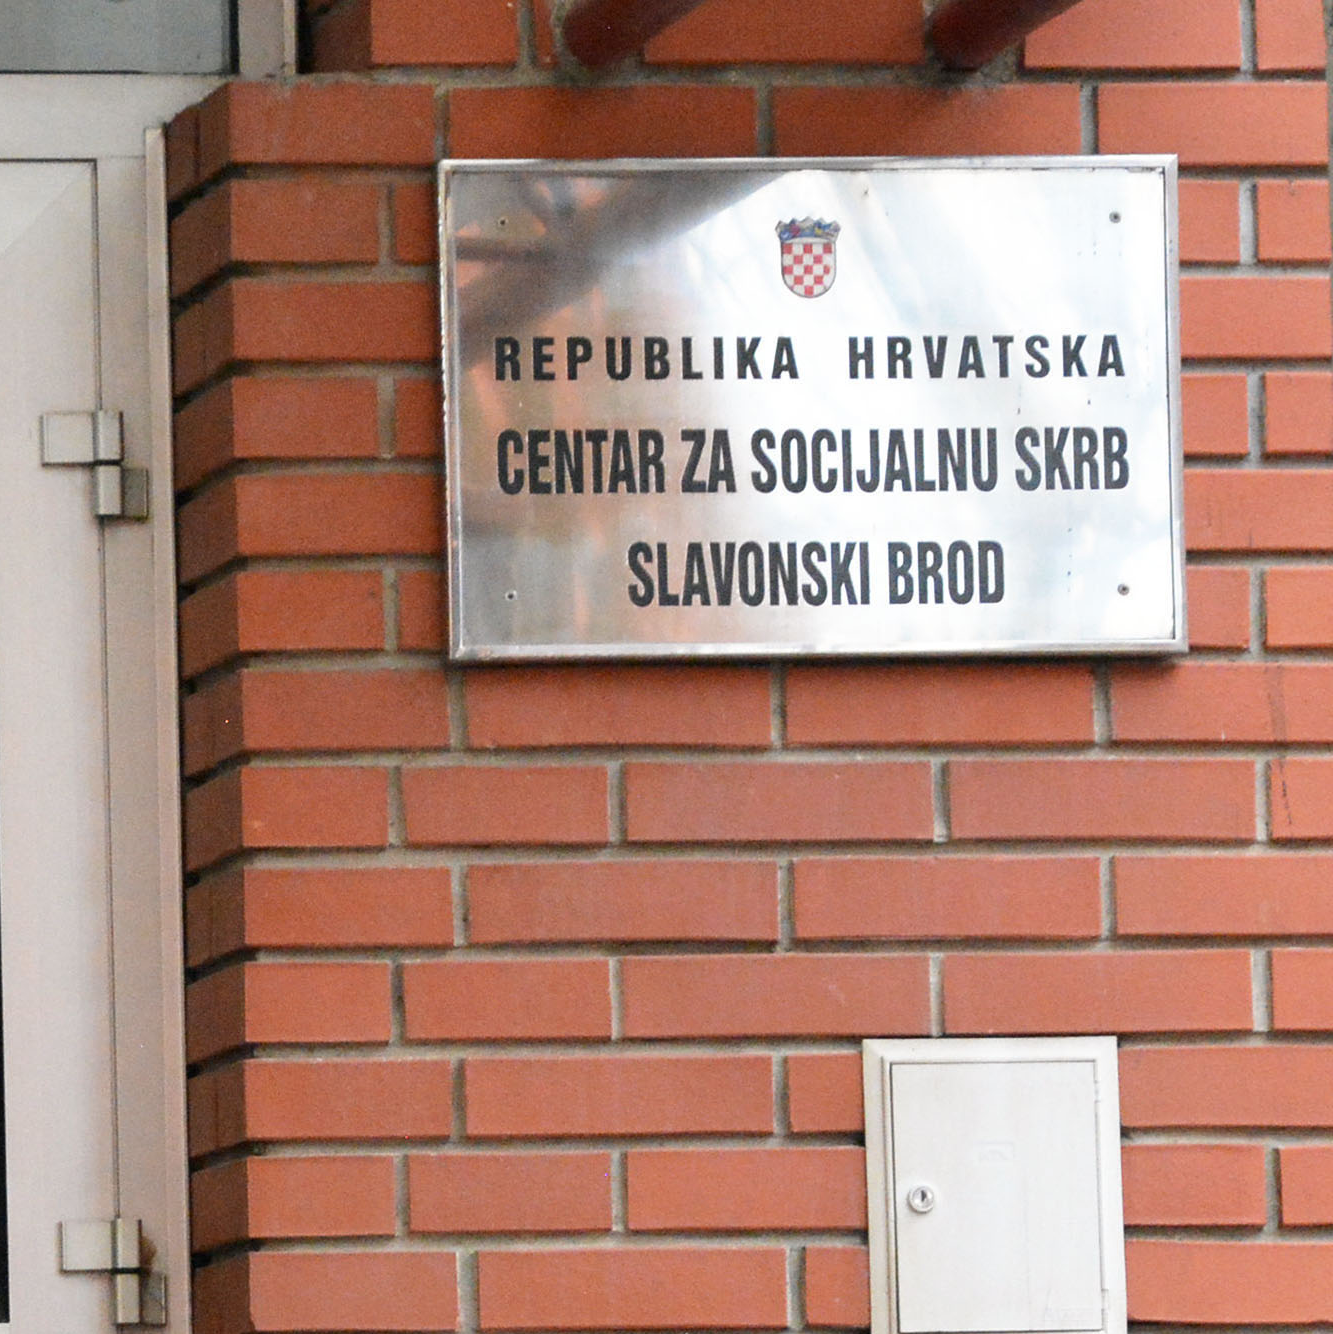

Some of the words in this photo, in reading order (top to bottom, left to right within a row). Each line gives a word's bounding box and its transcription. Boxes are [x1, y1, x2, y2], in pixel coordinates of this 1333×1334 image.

[494, 335, 800, 382] REPUBLIKA
[848, 333, 1127, 380] HRVATSKA
[496, 428, 666, 495] CENTAR
[680, 428, 737, 495] ZA
[750, 427, 999, 493] SOCIJALNU
[1014, 425, 1130, 492] SKRB
[627, 540, 871, 607] SLAVONSKI
[888, 539, 1005, 605] BROD
